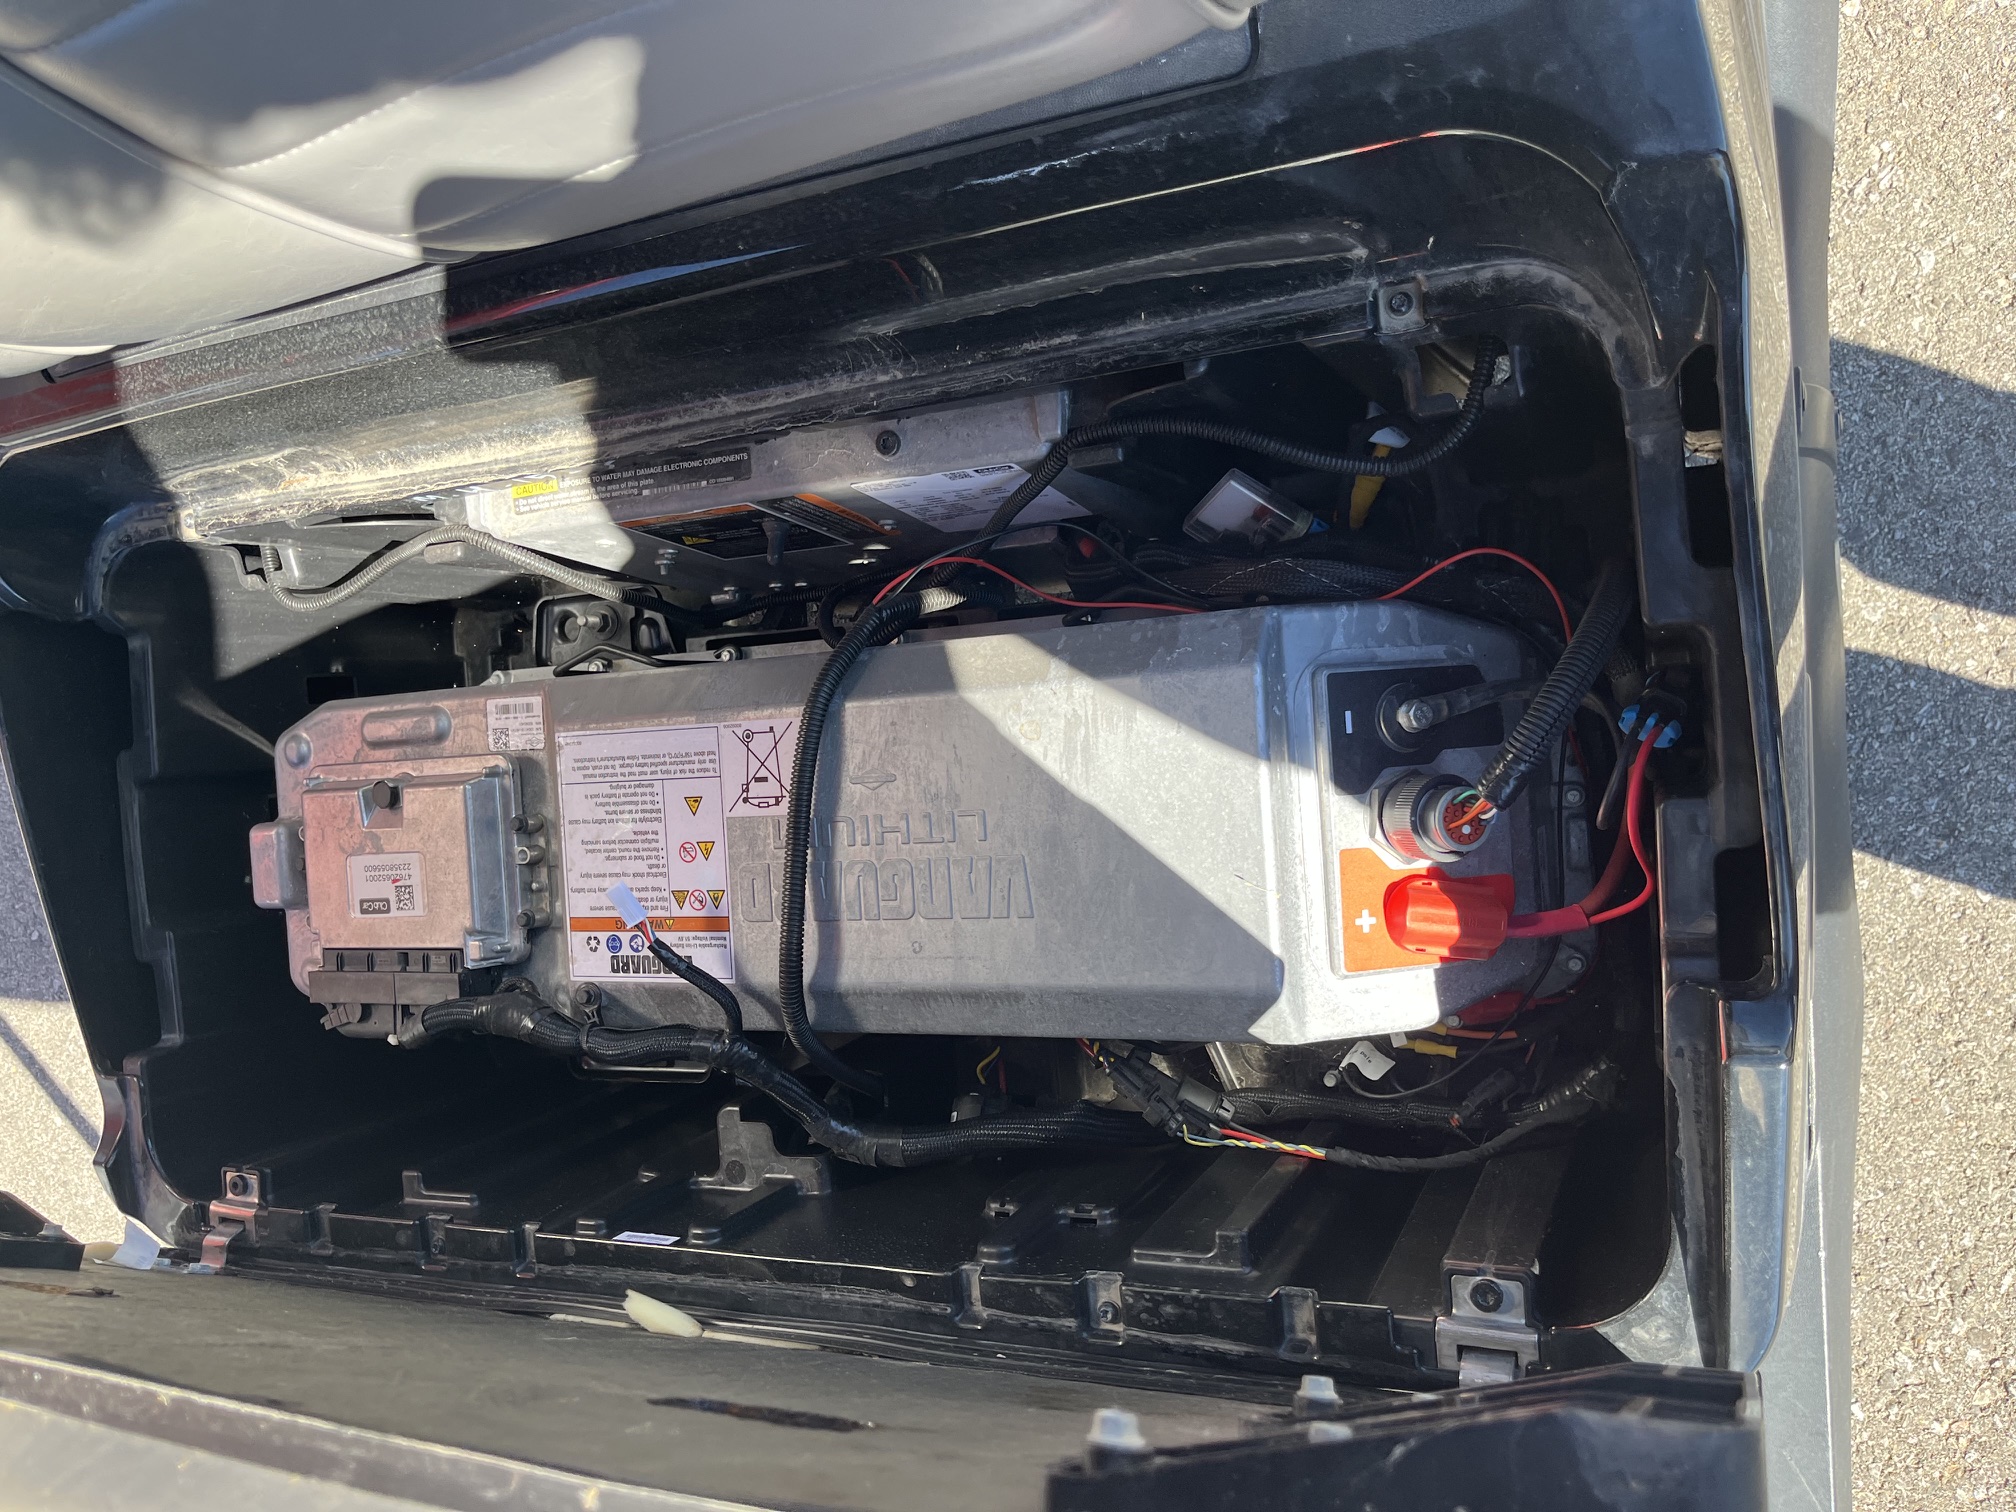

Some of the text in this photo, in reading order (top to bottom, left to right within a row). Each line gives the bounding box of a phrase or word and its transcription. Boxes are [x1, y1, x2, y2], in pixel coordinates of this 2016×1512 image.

[560, 477, 591, 488] EXPOSURE
[600, 473, 621, 482] WATER
[622, 470, 635, 478] MAY
[636, 465, 662, 476] DAMAGE
[663, 459, 702, 472] ELECTRONIC
[704, 452, 748, 466] COMPONENTS
[516, 481, 554, 495] CAUTION
[597, 485, 606, 493] the
[592, 492, 610, 500] before
[638, 816, 662, 824] Electrolyte
[362, 902, 388, 911] Club Car
[669, 941, 685, 950] Battery
[610, 955, 693, 975] GUARD
